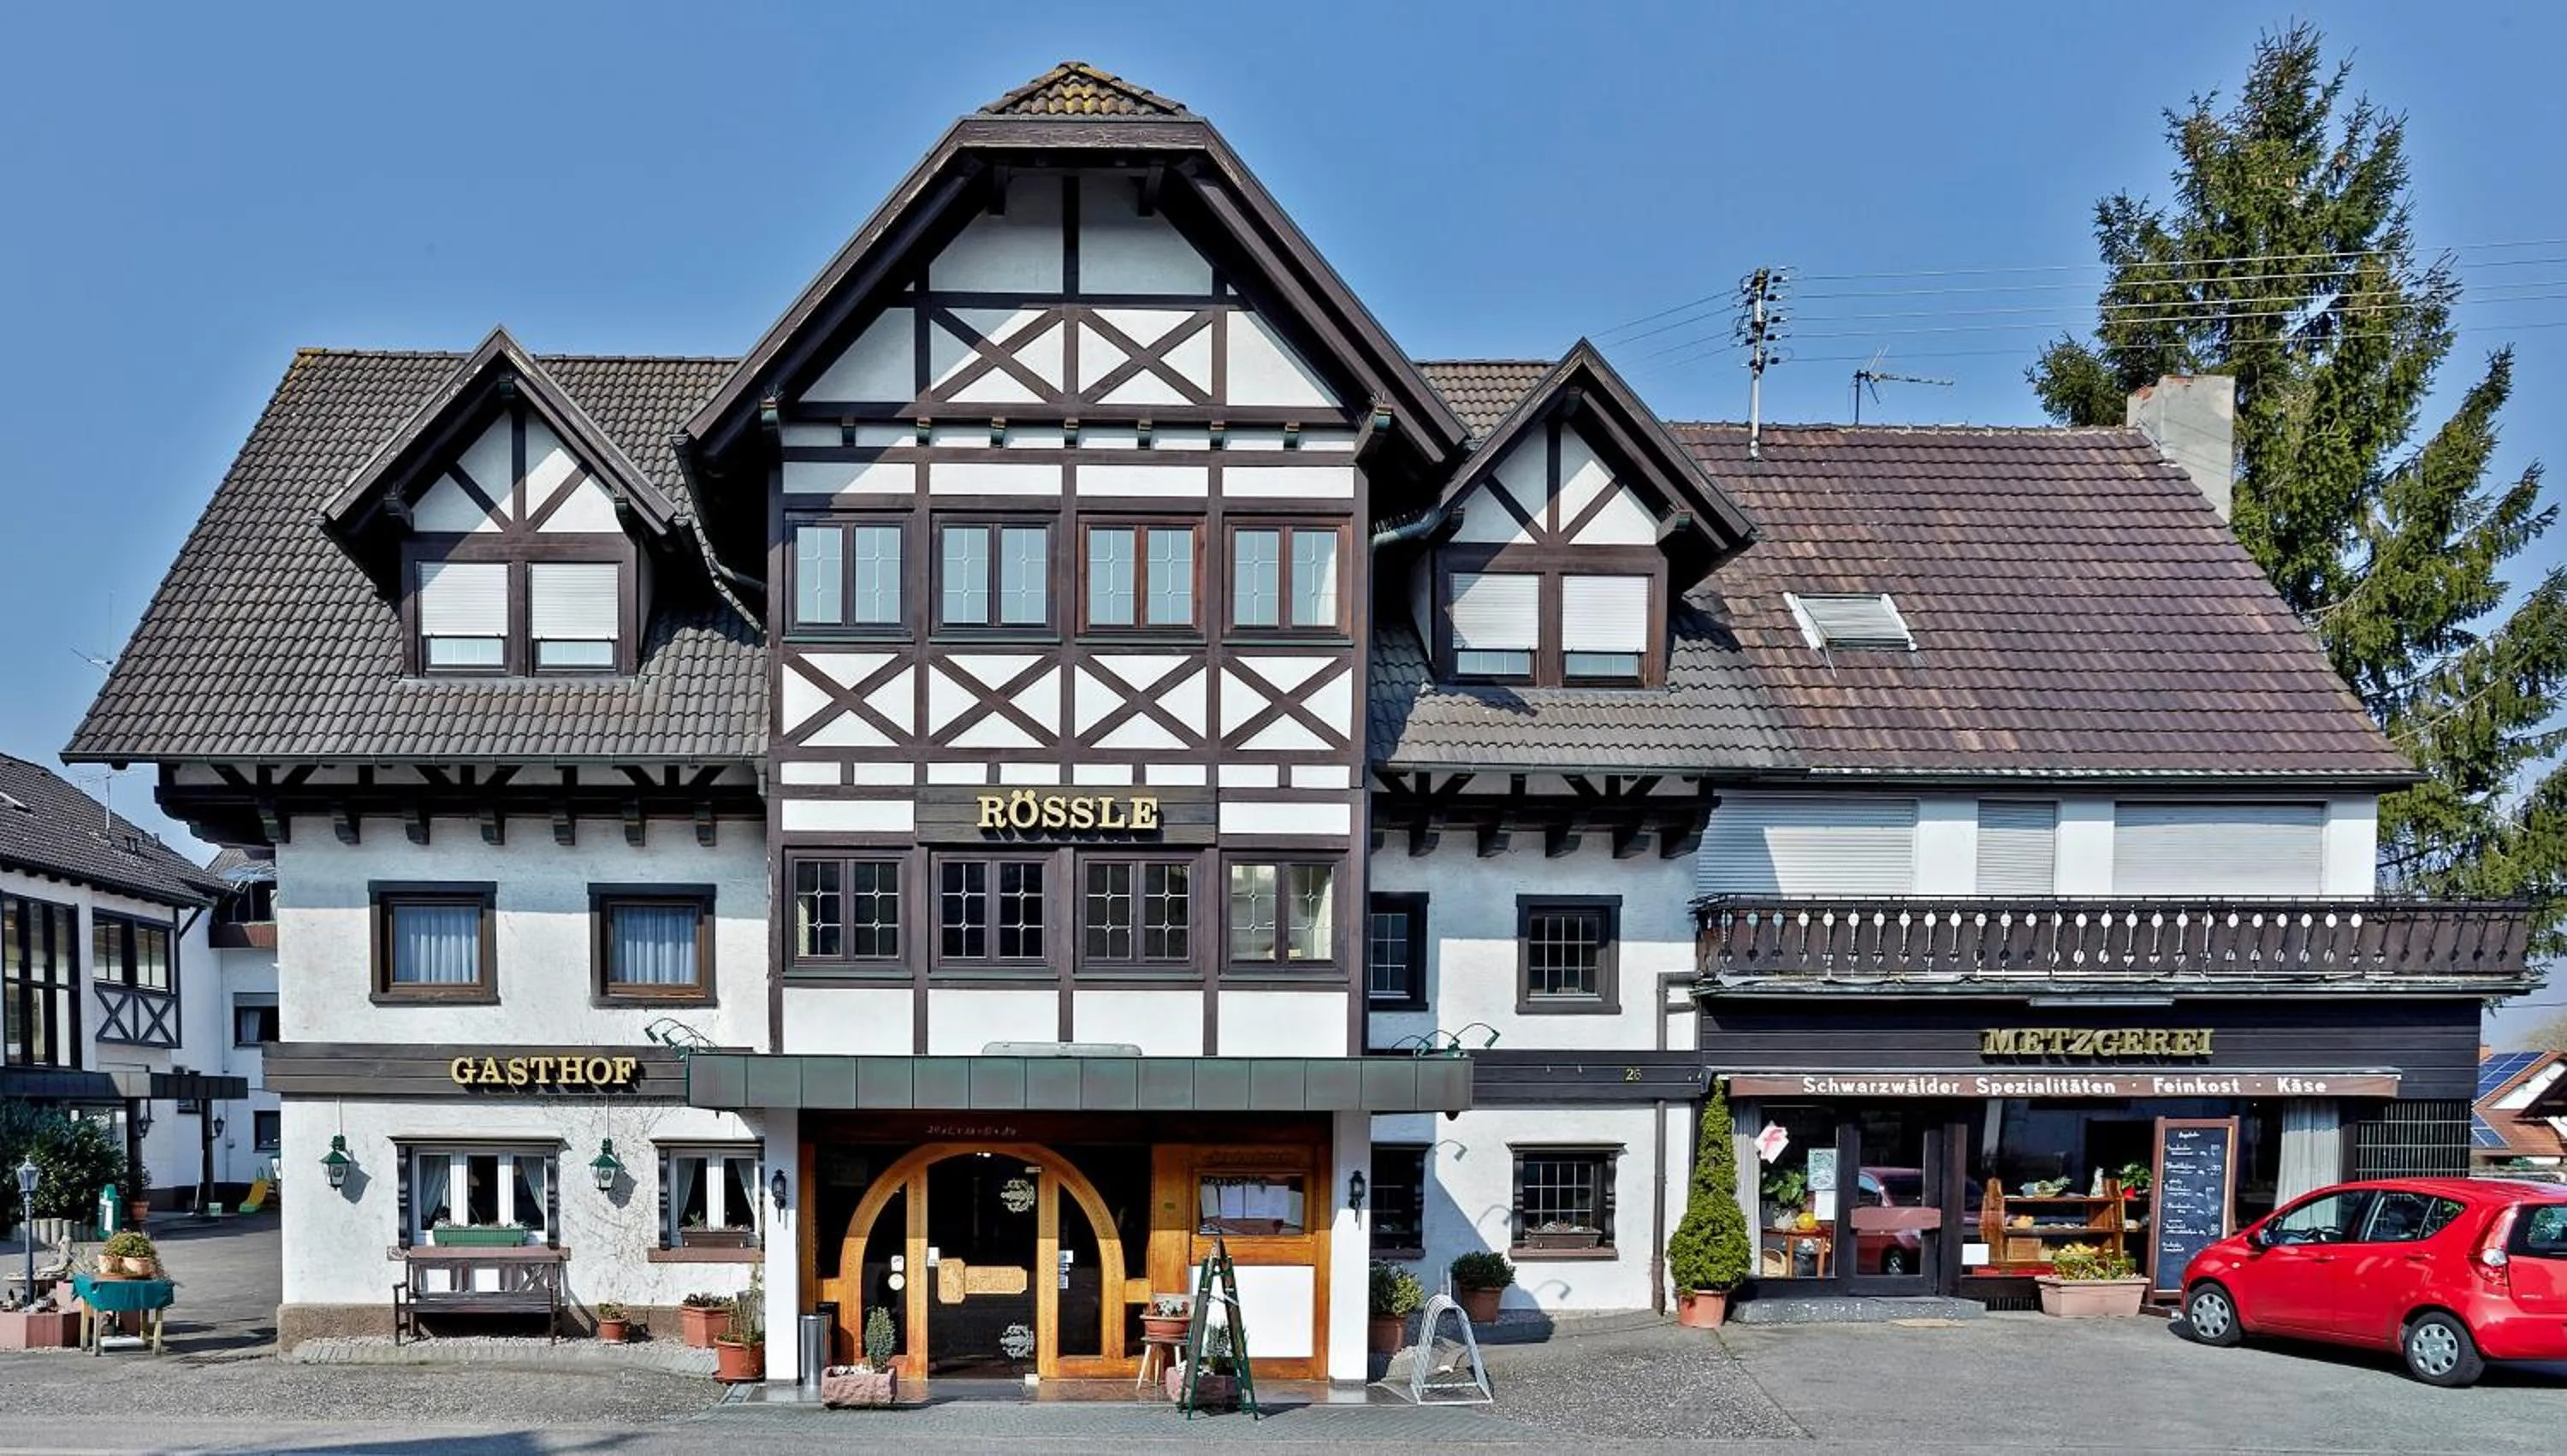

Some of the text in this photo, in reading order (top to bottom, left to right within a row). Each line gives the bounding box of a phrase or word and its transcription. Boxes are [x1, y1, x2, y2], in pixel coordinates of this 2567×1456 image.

[976, 789, 1159, 830] RÖSSLE
[1982, 1027, 2214, 1056] METZGEREI
[450, 1056, 637, 1086] GASTHOF
[1802, 1075, 2327, 1095] Schwarzwälder Spezialitäten Feinkost Käse
